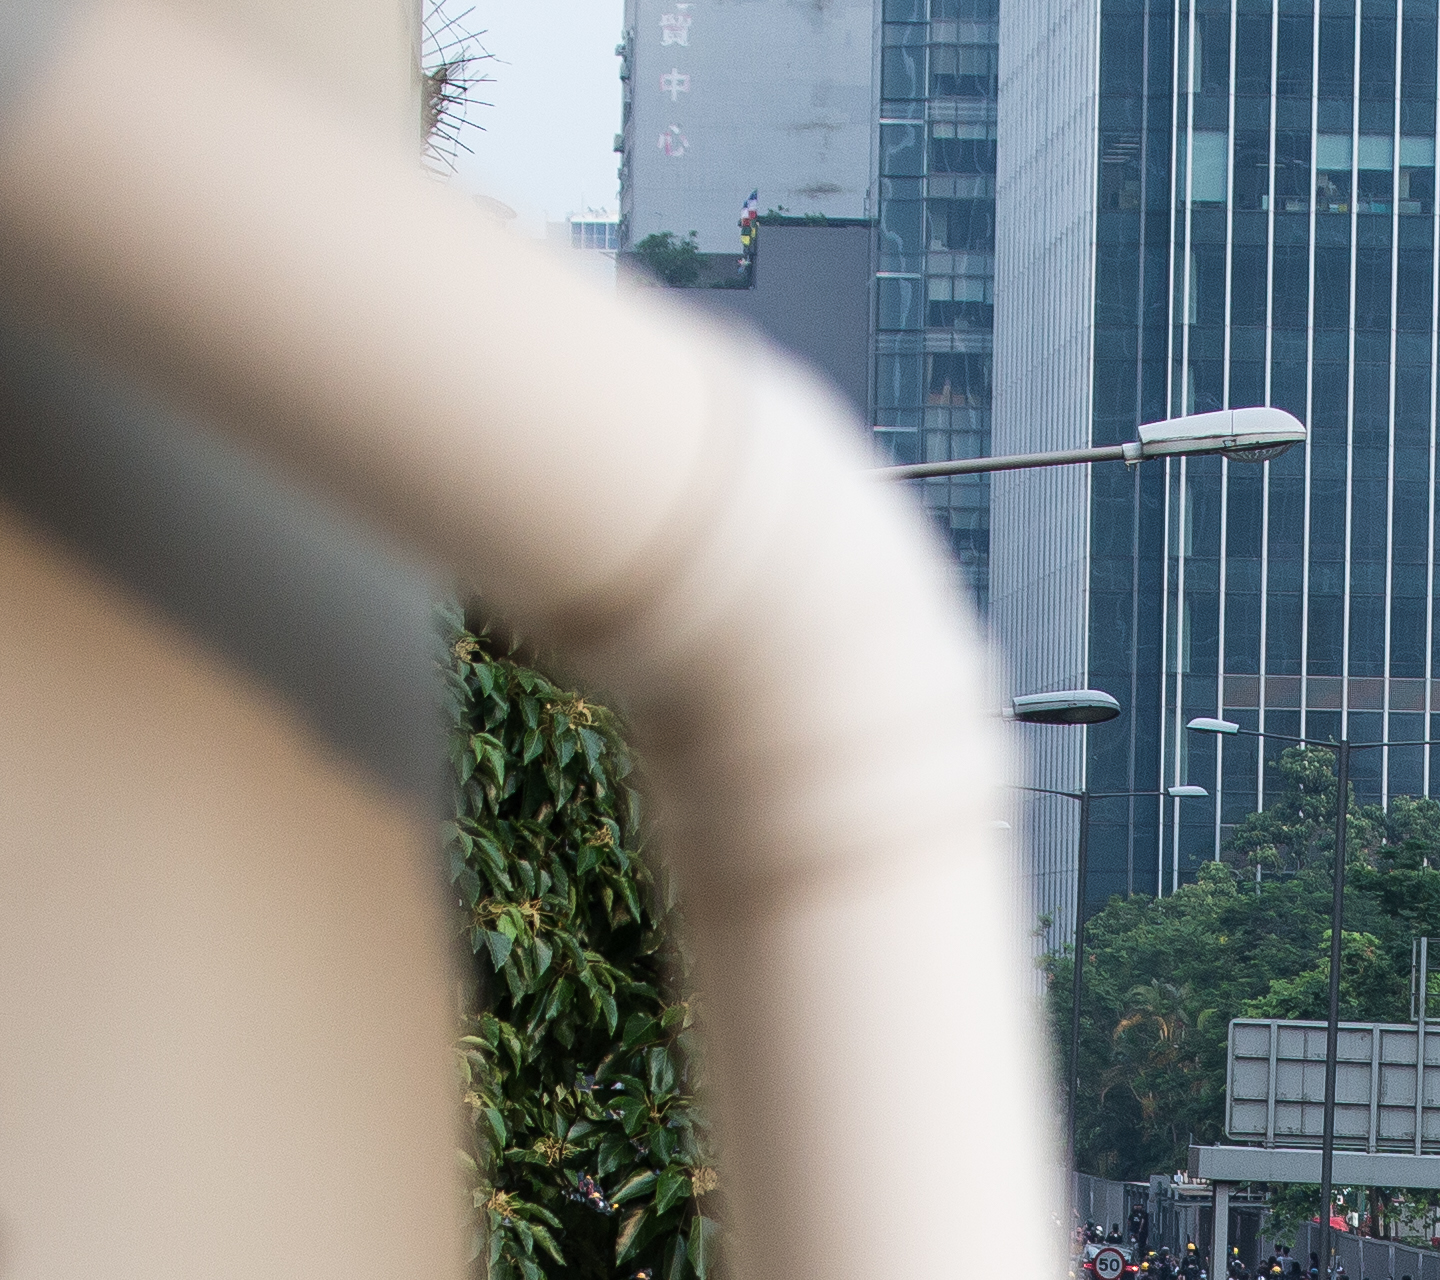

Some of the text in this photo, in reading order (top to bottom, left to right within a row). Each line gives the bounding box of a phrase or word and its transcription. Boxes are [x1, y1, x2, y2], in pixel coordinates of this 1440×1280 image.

[657, 3, 694, 157] 貿中心
[1098, 1258, 1120, 1272] 50
